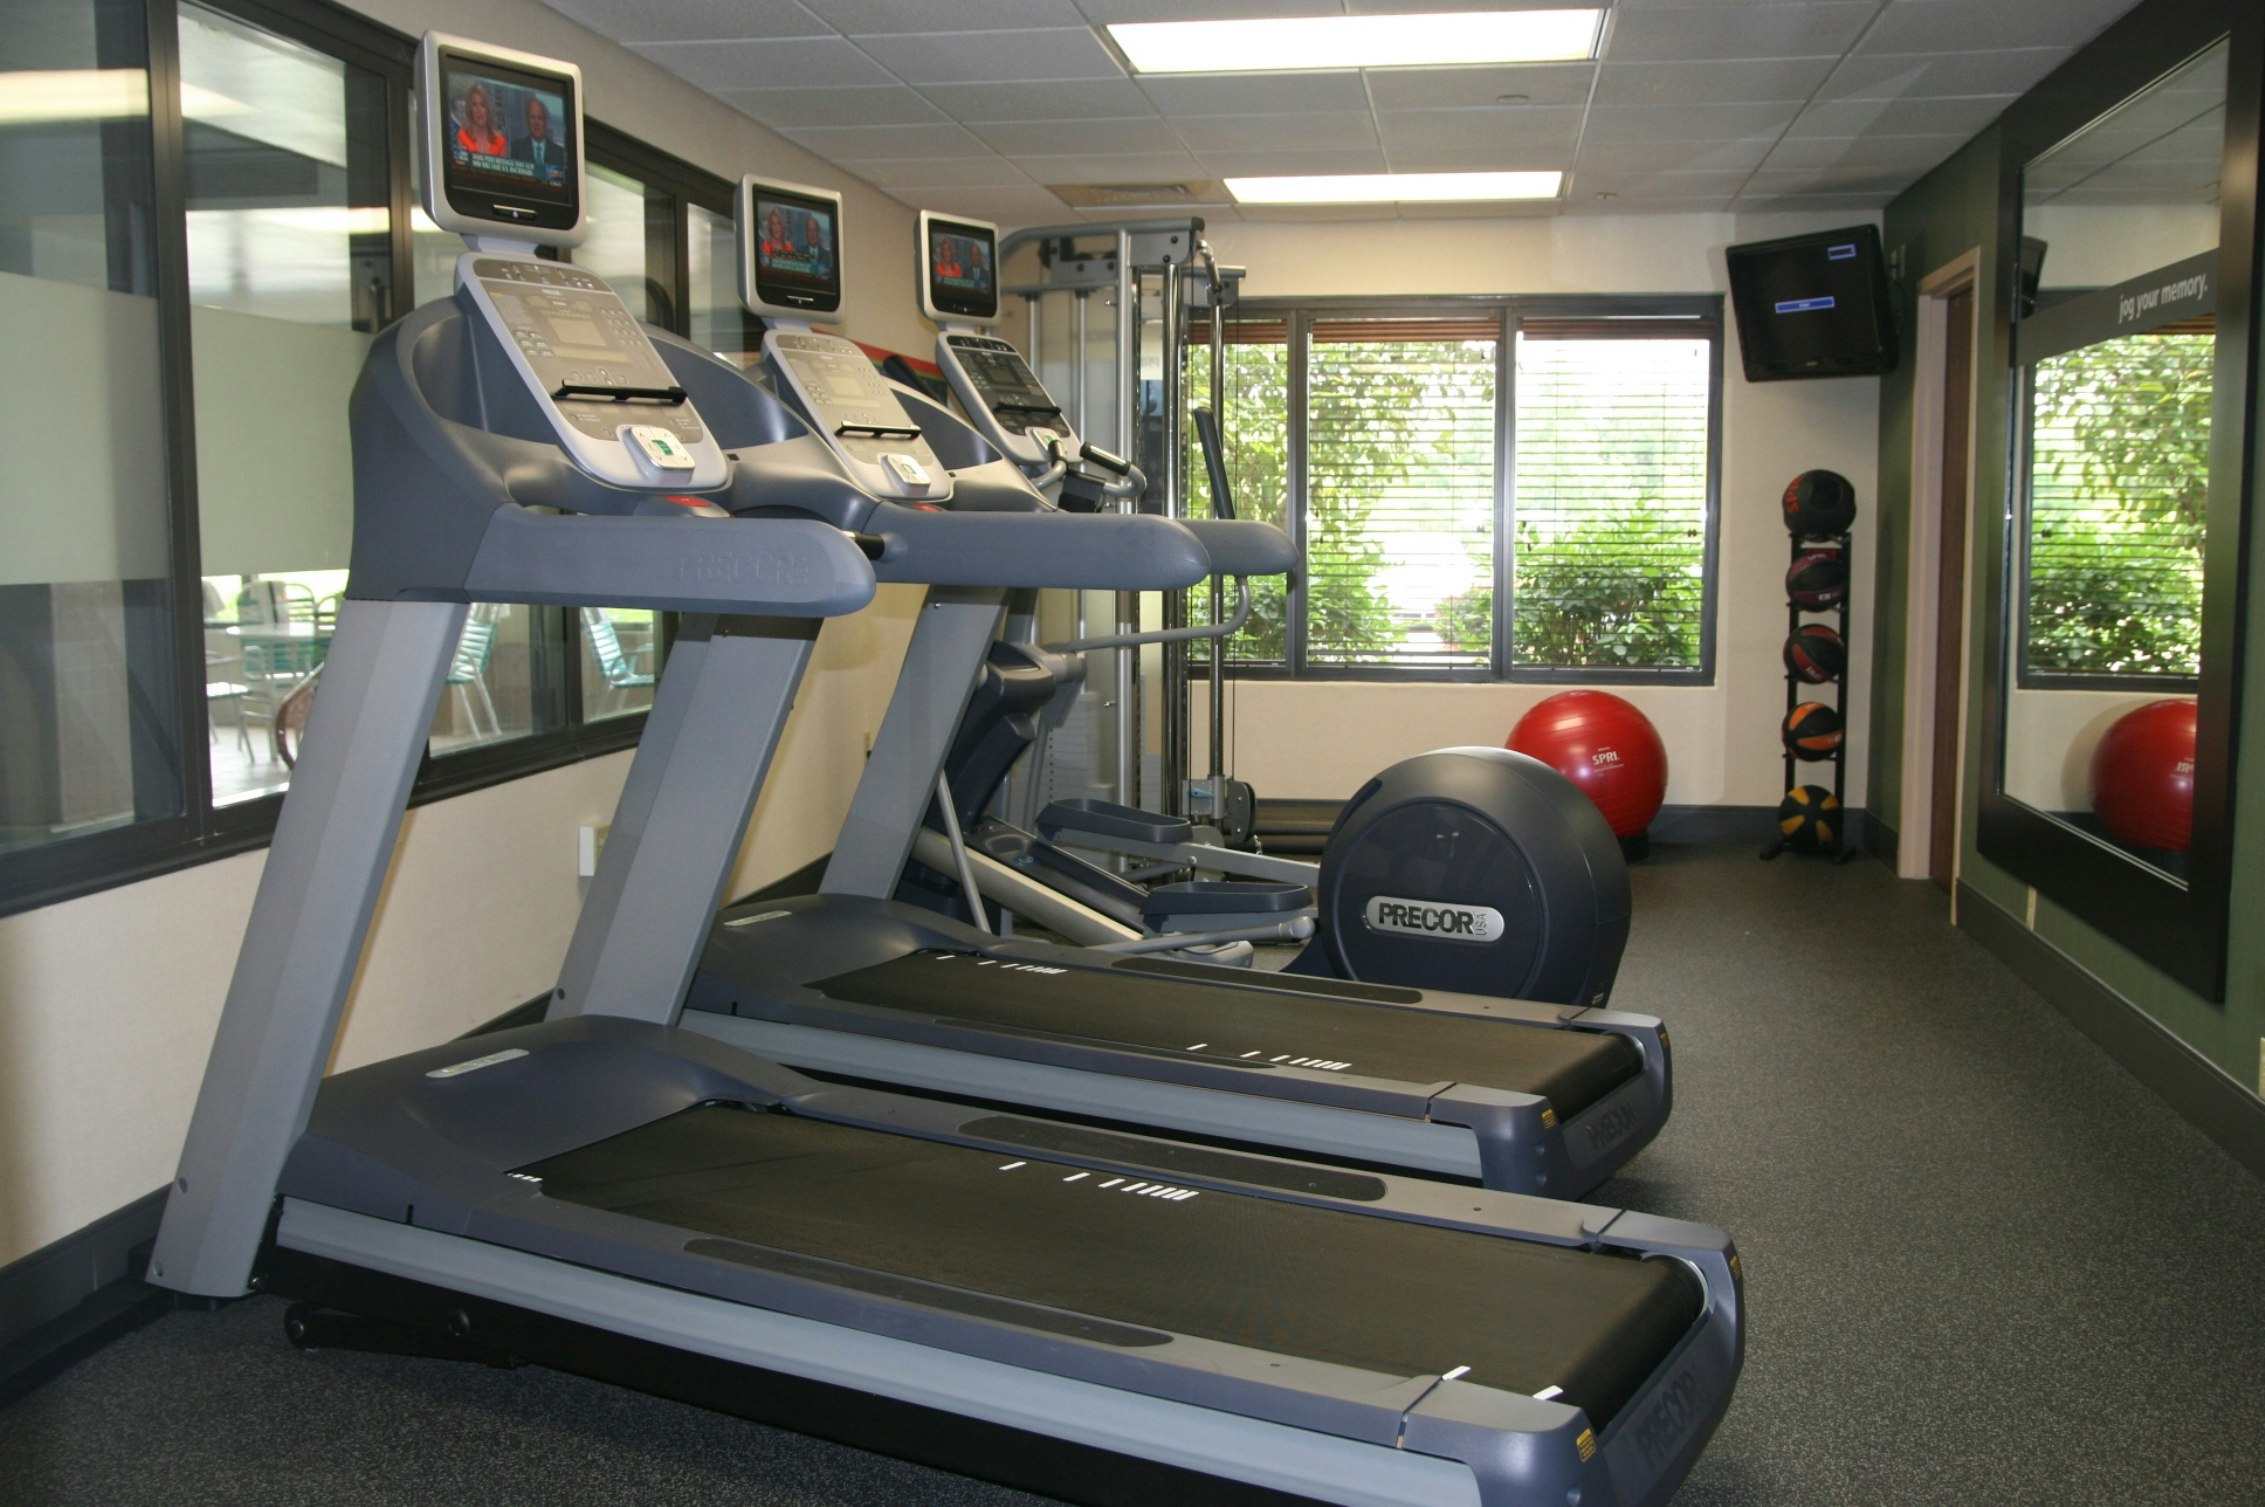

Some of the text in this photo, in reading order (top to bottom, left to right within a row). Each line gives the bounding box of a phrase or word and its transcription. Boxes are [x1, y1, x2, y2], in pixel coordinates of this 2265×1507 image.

[2118, 273, 2208, 324] jog your memory.
[1592, 751, 1618, 766] SPRI
[1378, 902, 1488, 936] PRECOR USA
